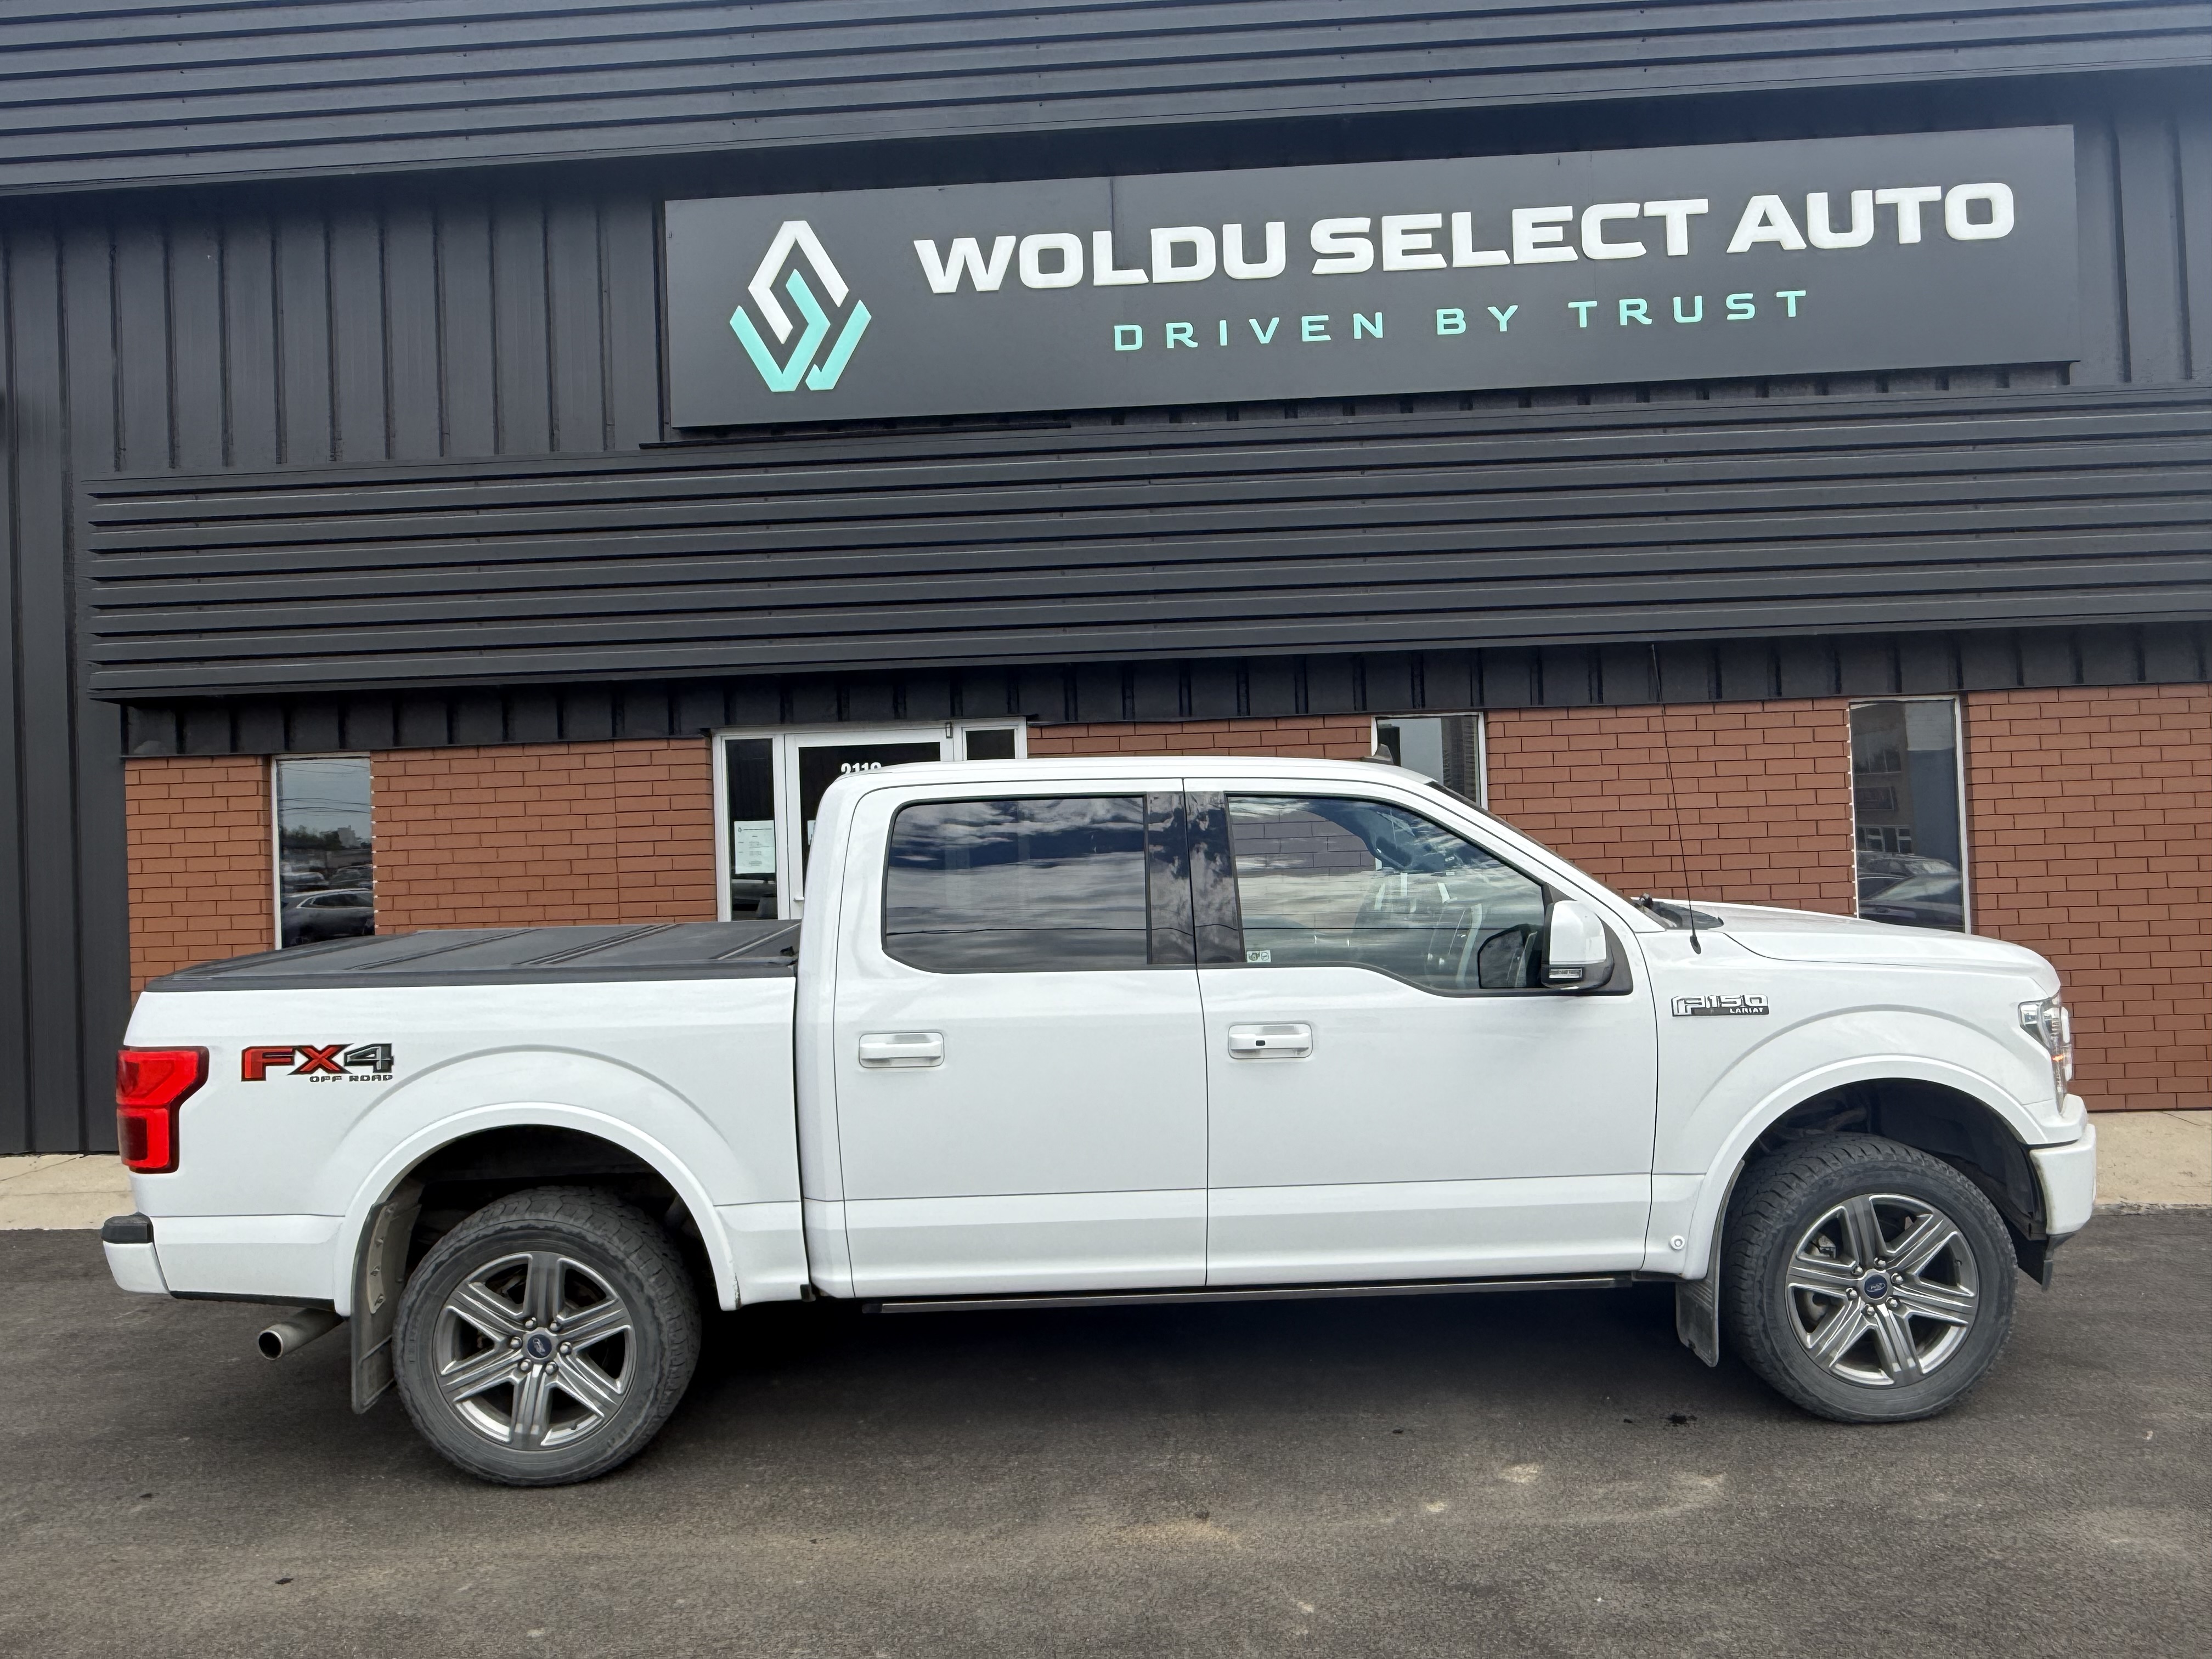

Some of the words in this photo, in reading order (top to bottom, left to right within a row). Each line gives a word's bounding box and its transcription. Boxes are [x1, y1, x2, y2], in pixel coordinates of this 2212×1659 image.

[913, 221, 1286, 294] WOLDU
[1310, 198, 1709, 275] SELECT
[1726, 182, 2015, 253] AUTO
[1114, 312, 1384, 352] DRIVEN
[1436, 304, 1519, 335] BY
[1567, 289, 1807, 329] TRUST
[241, 1042, 394, 1082] FX4
